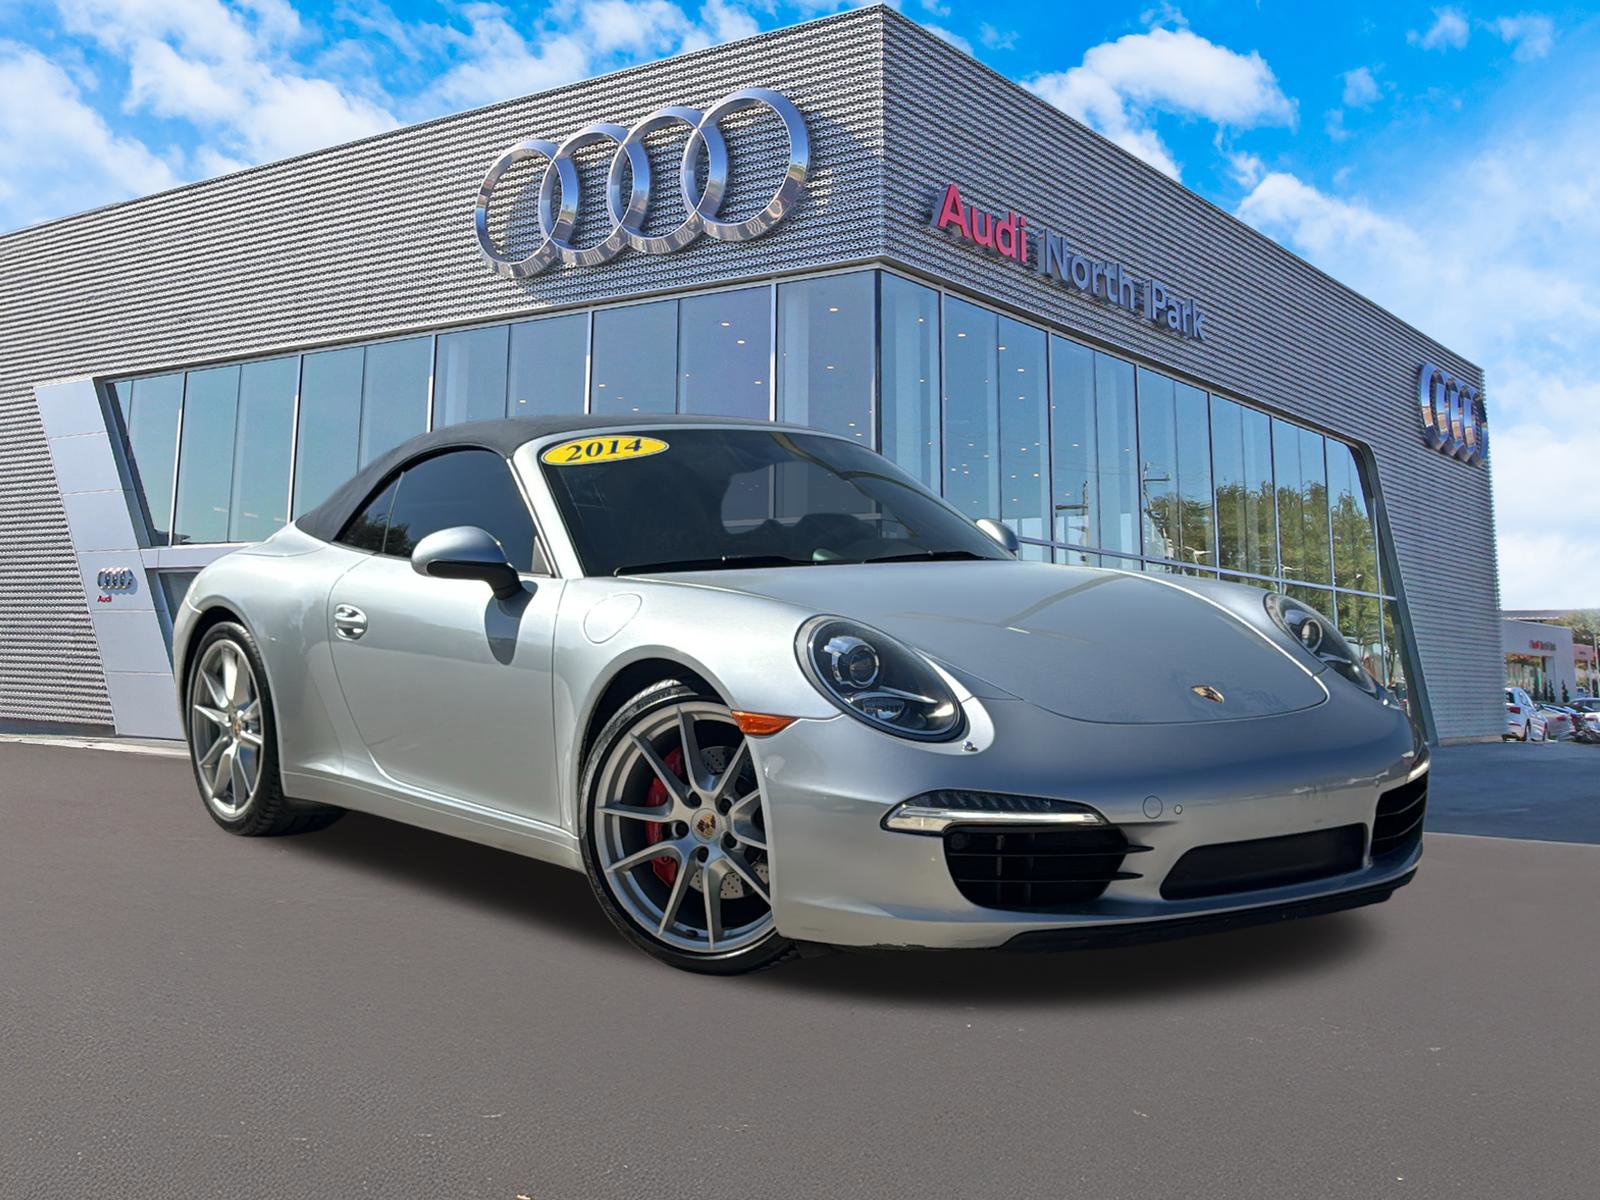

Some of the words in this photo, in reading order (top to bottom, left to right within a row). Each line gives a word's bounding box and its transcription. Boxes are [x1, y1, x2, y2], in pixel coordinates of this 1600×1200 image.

[933, 183, 1027, 263] Audi
[1038, 229, 1136, 310] North
[1144, 279, 1207, 341] Park
[566, 439, 642, 461] 2014
